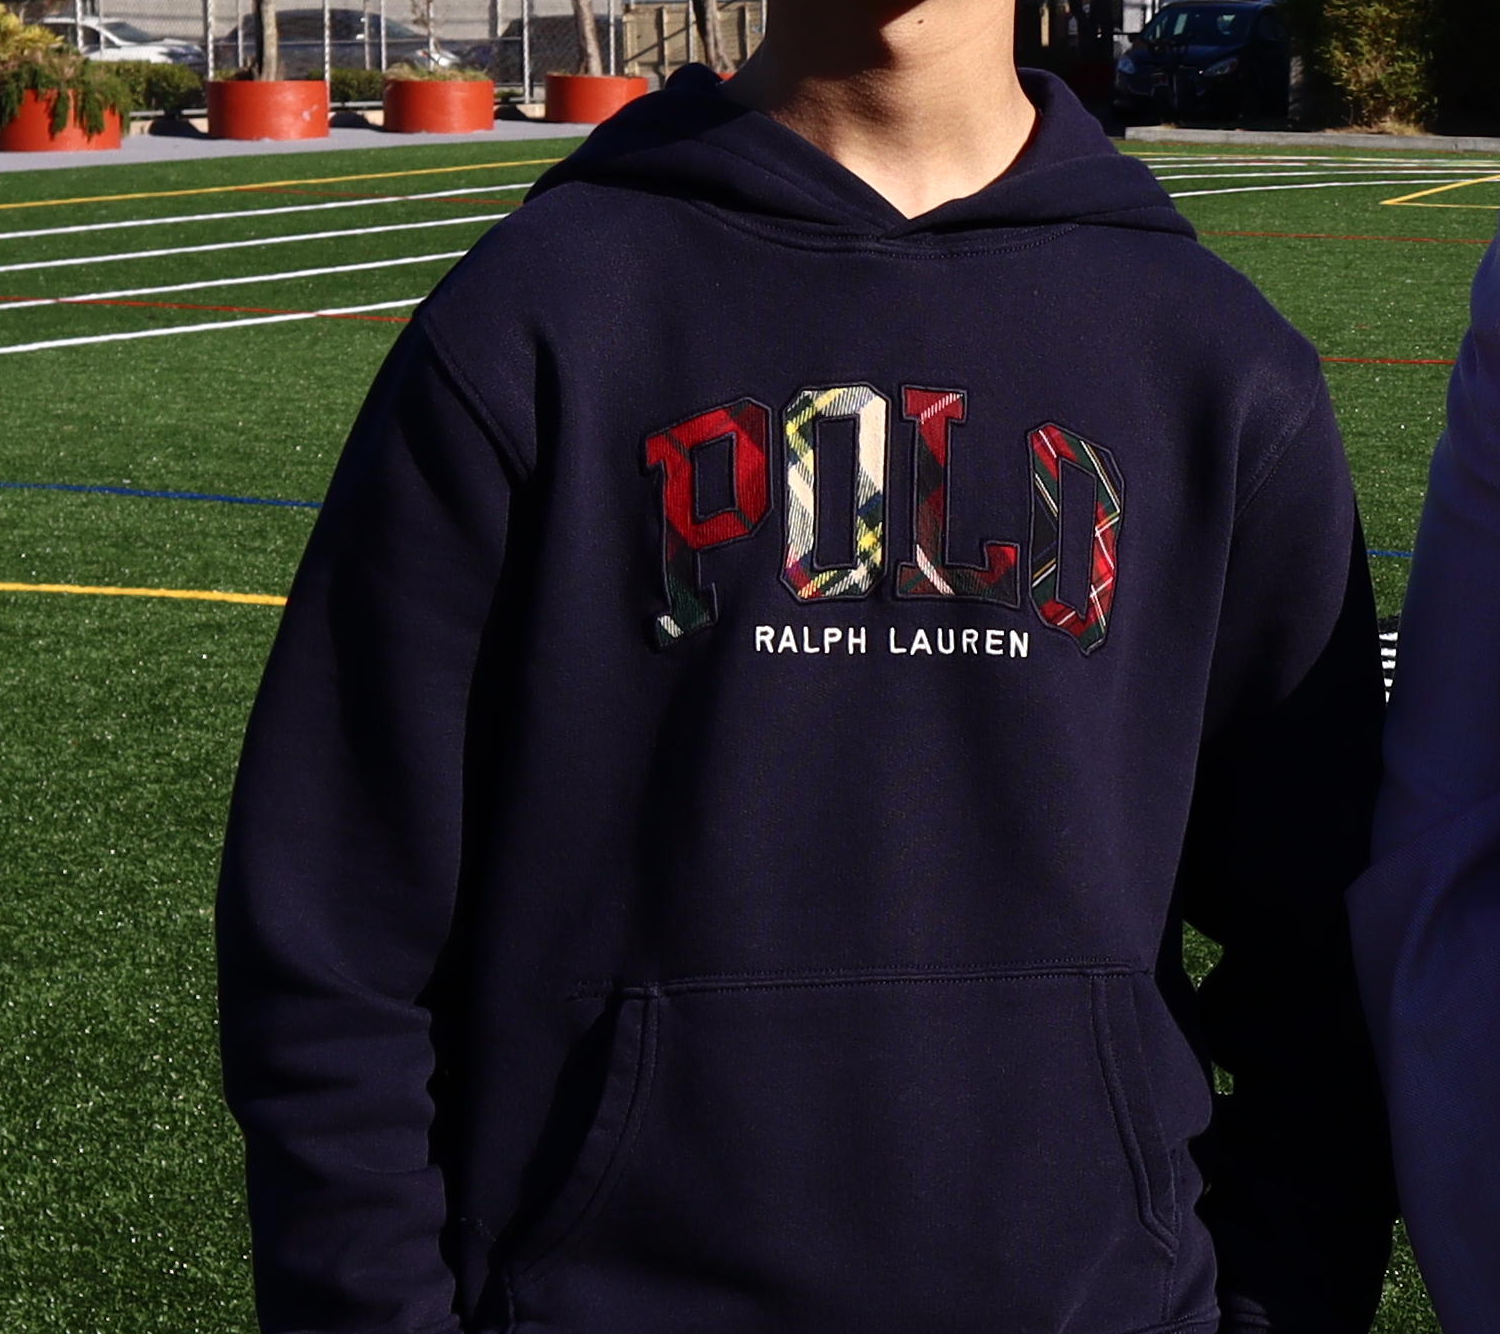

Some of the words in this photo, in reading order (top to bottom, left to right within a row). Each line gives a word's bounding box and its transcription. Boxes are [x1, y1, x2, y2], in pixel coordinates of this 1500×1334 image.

[645, 382, 1125, 655] POLO
[754, 624, 867, 655] RALPH
[888, 625, 1030, 658] LAUREN
